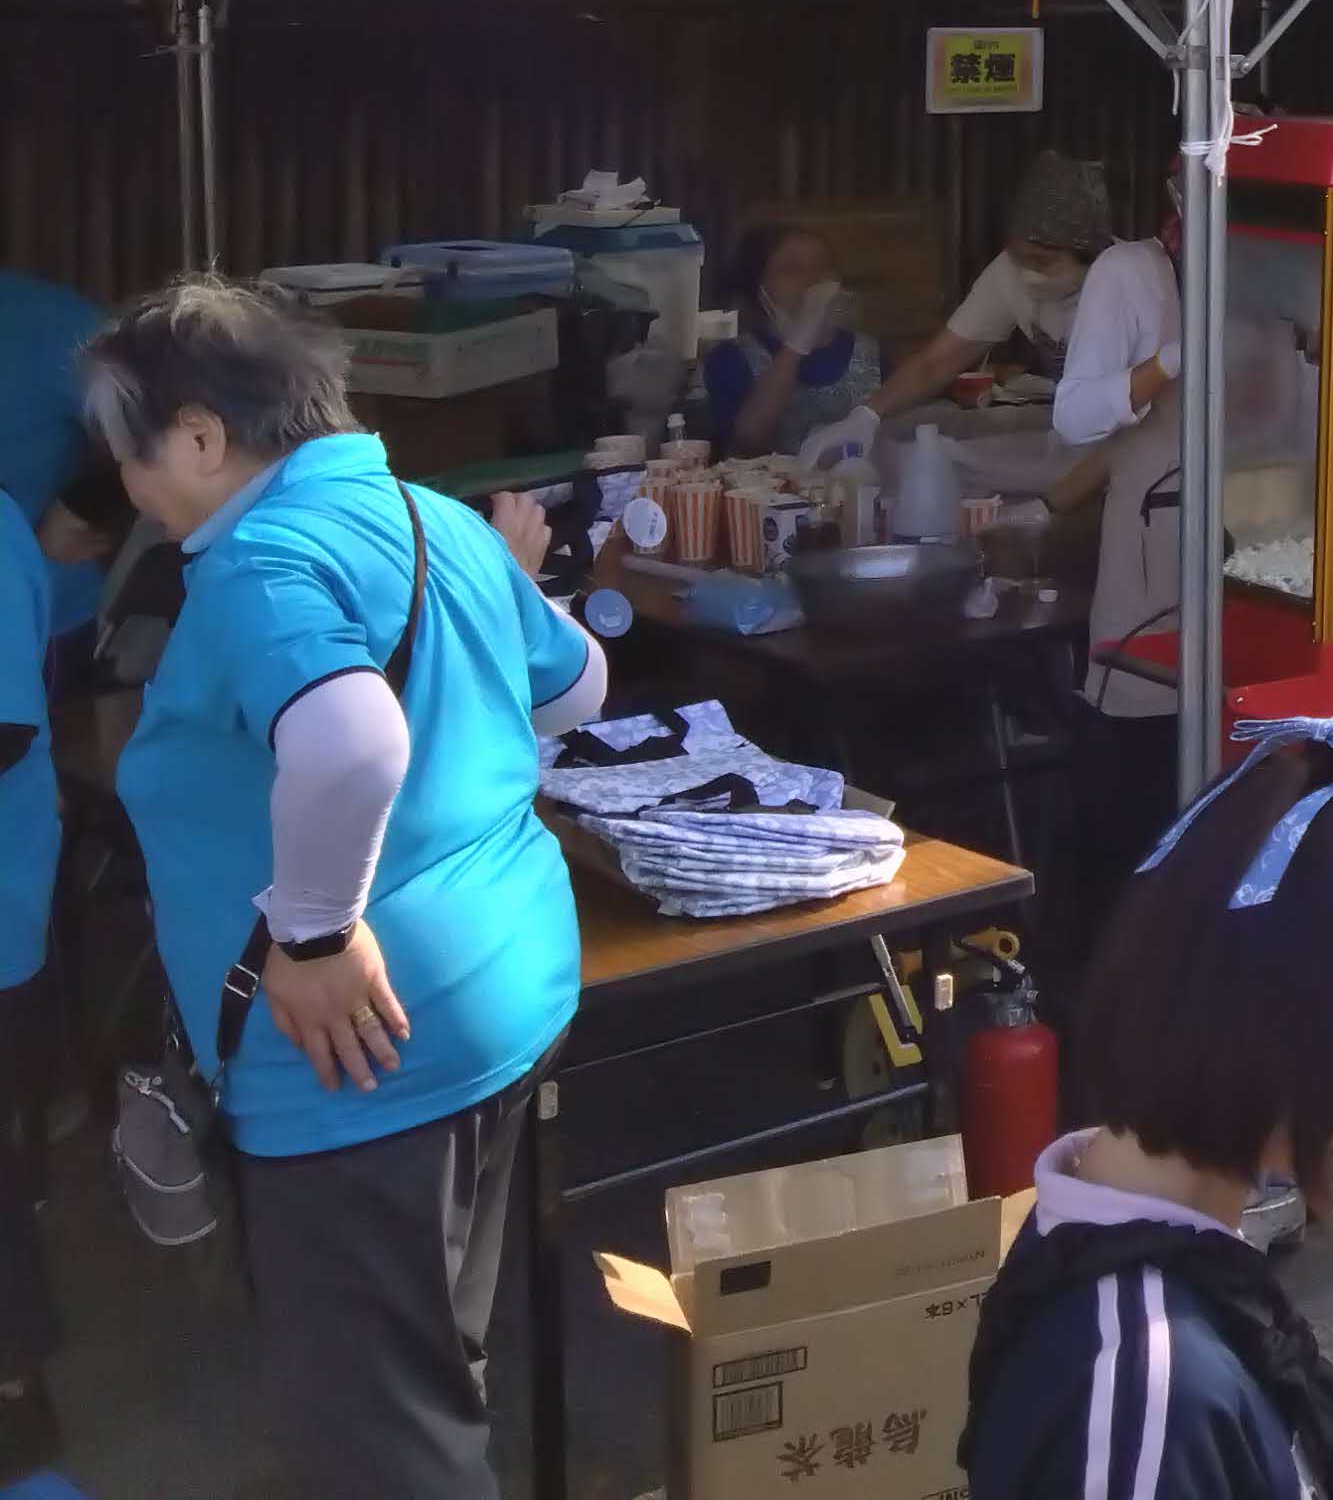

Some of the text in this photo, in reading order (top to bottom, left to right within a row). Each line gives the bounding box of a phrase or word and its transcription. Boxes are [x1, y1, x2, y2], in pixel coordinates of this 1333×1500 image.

[950, 52, 1016, 84] 禁煙
[777, 1408, 927, 1483] 烏龍茶
